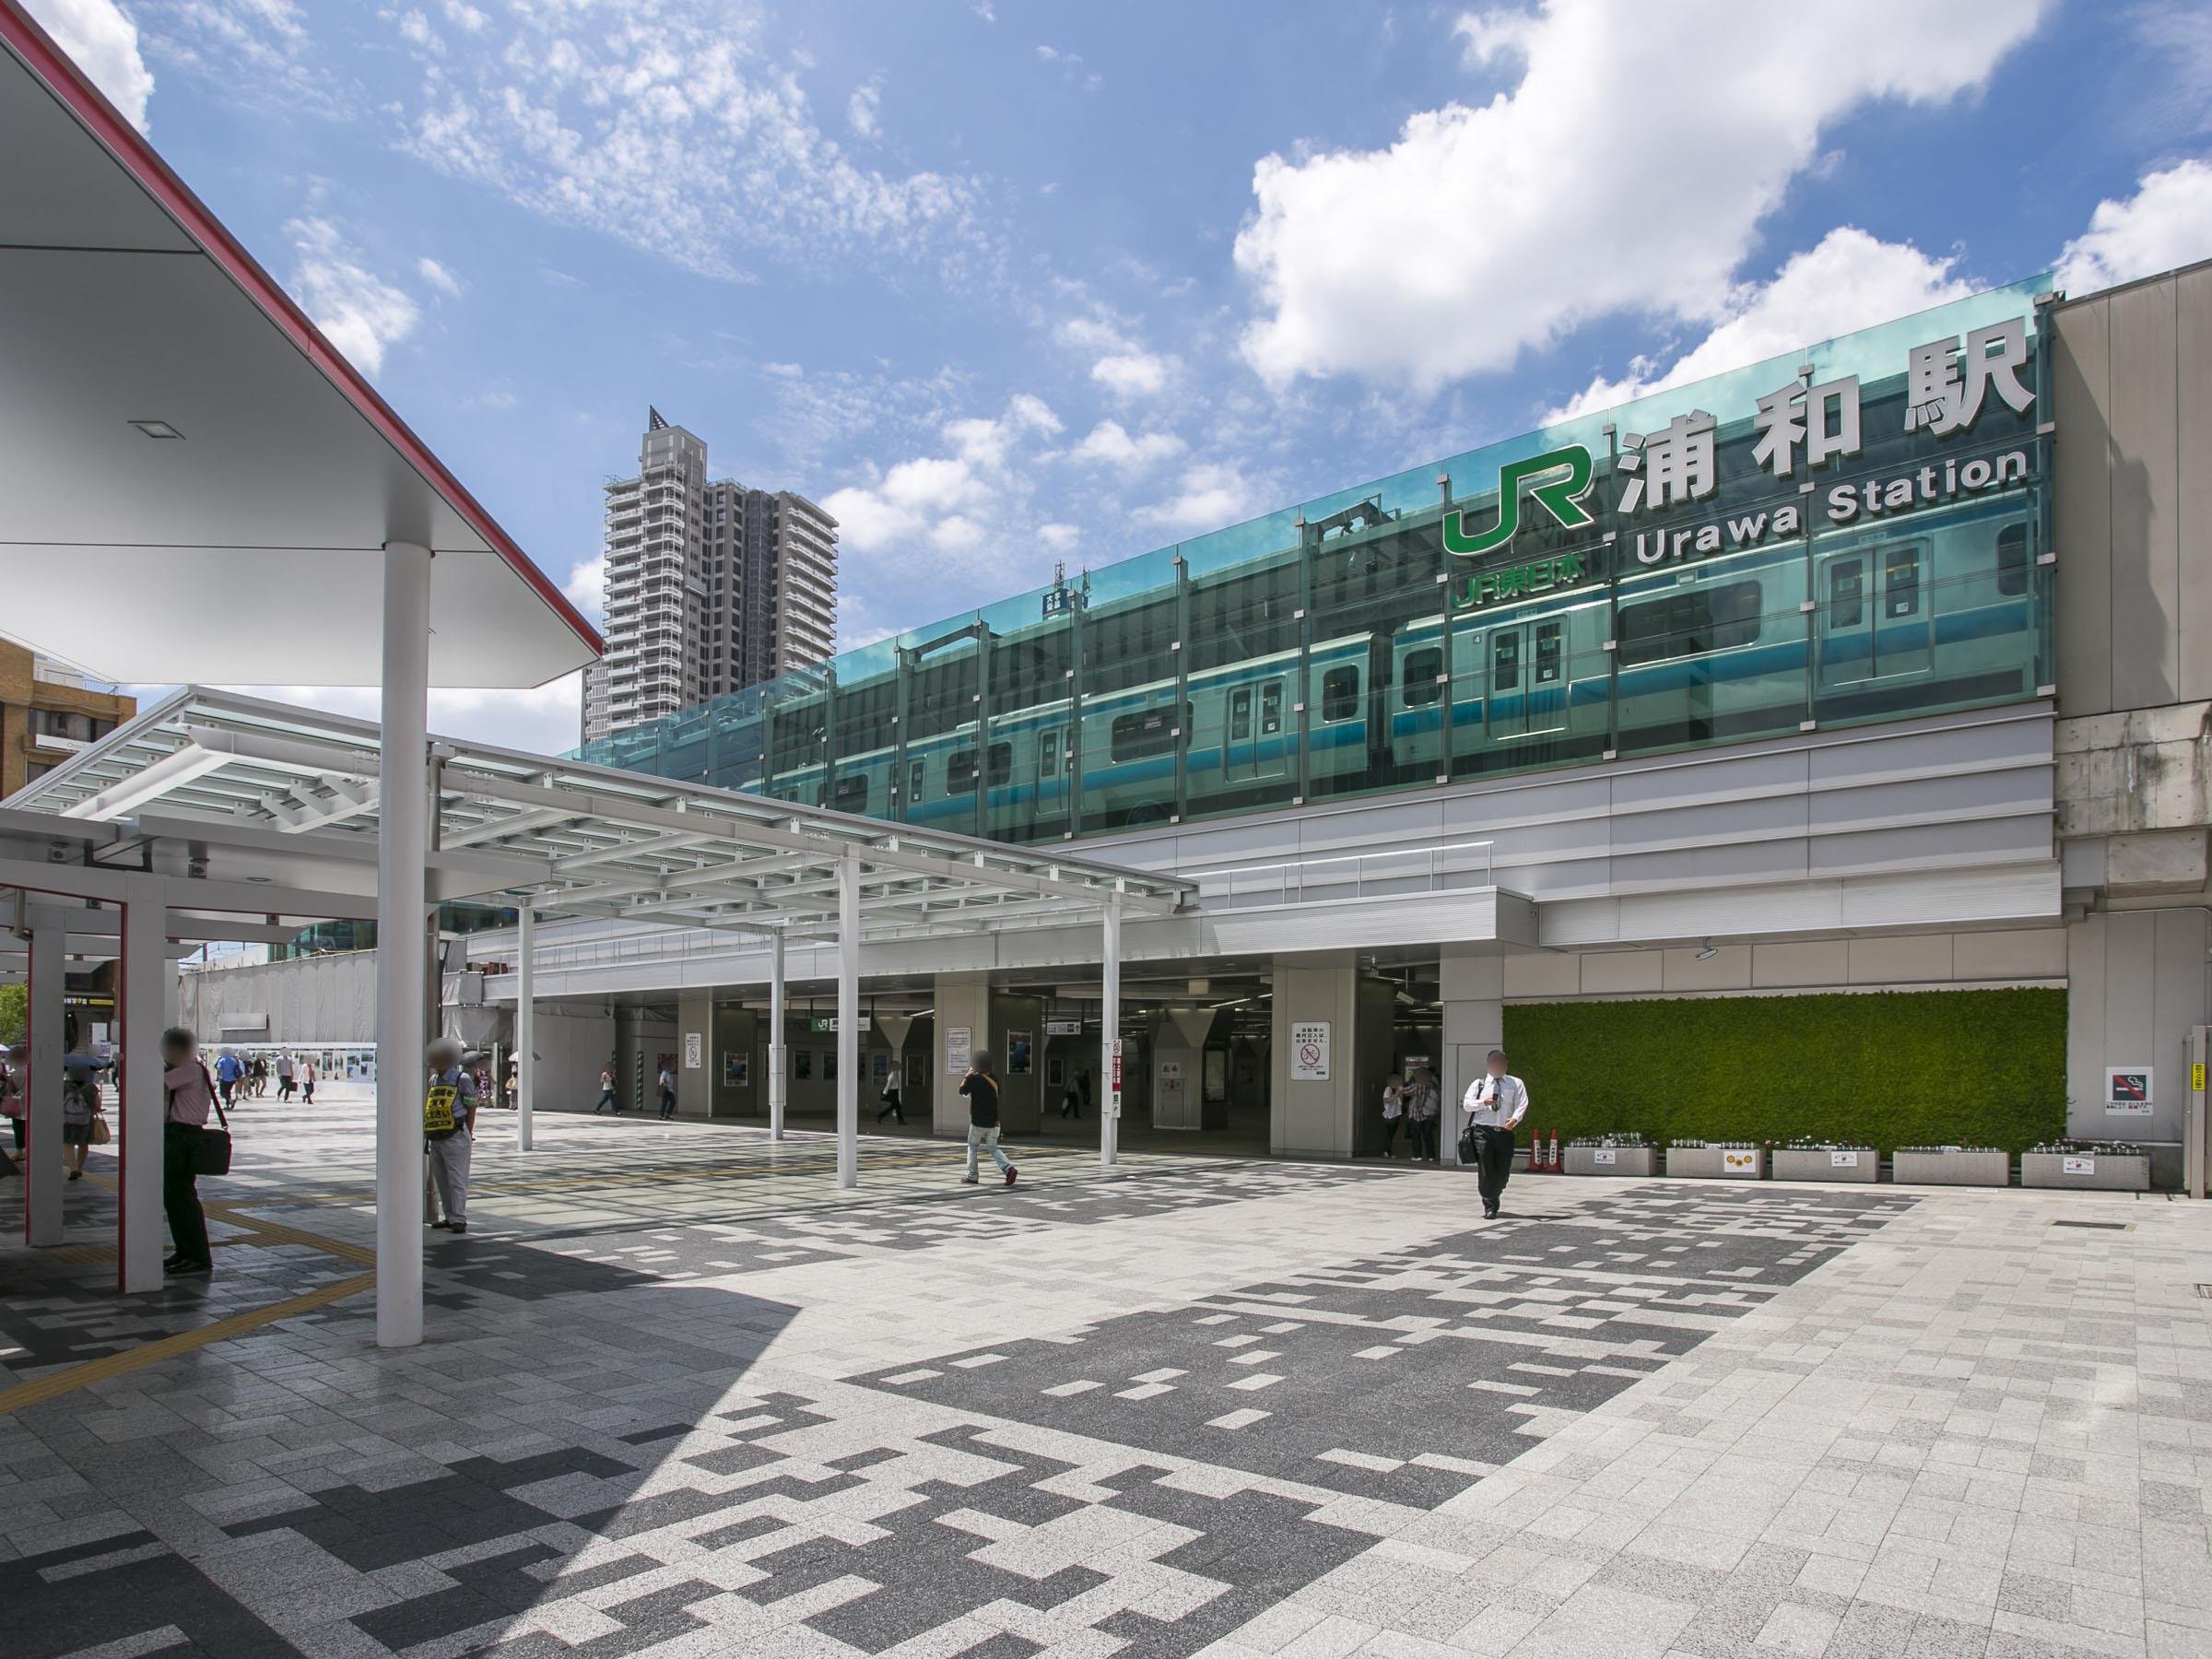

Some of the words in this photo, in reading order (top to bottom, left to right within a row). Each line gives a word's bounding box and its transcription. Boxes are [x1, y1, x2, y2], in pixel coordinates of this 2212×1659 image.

[1443, 443, 1594, 556] JR
[1637, 506, 1799, 565] Urawa
[1827, 450, 2027, 522] Station
[1453, 553, 1585, 608] JR東日本
[818, 1018, 829, 1028] JR
